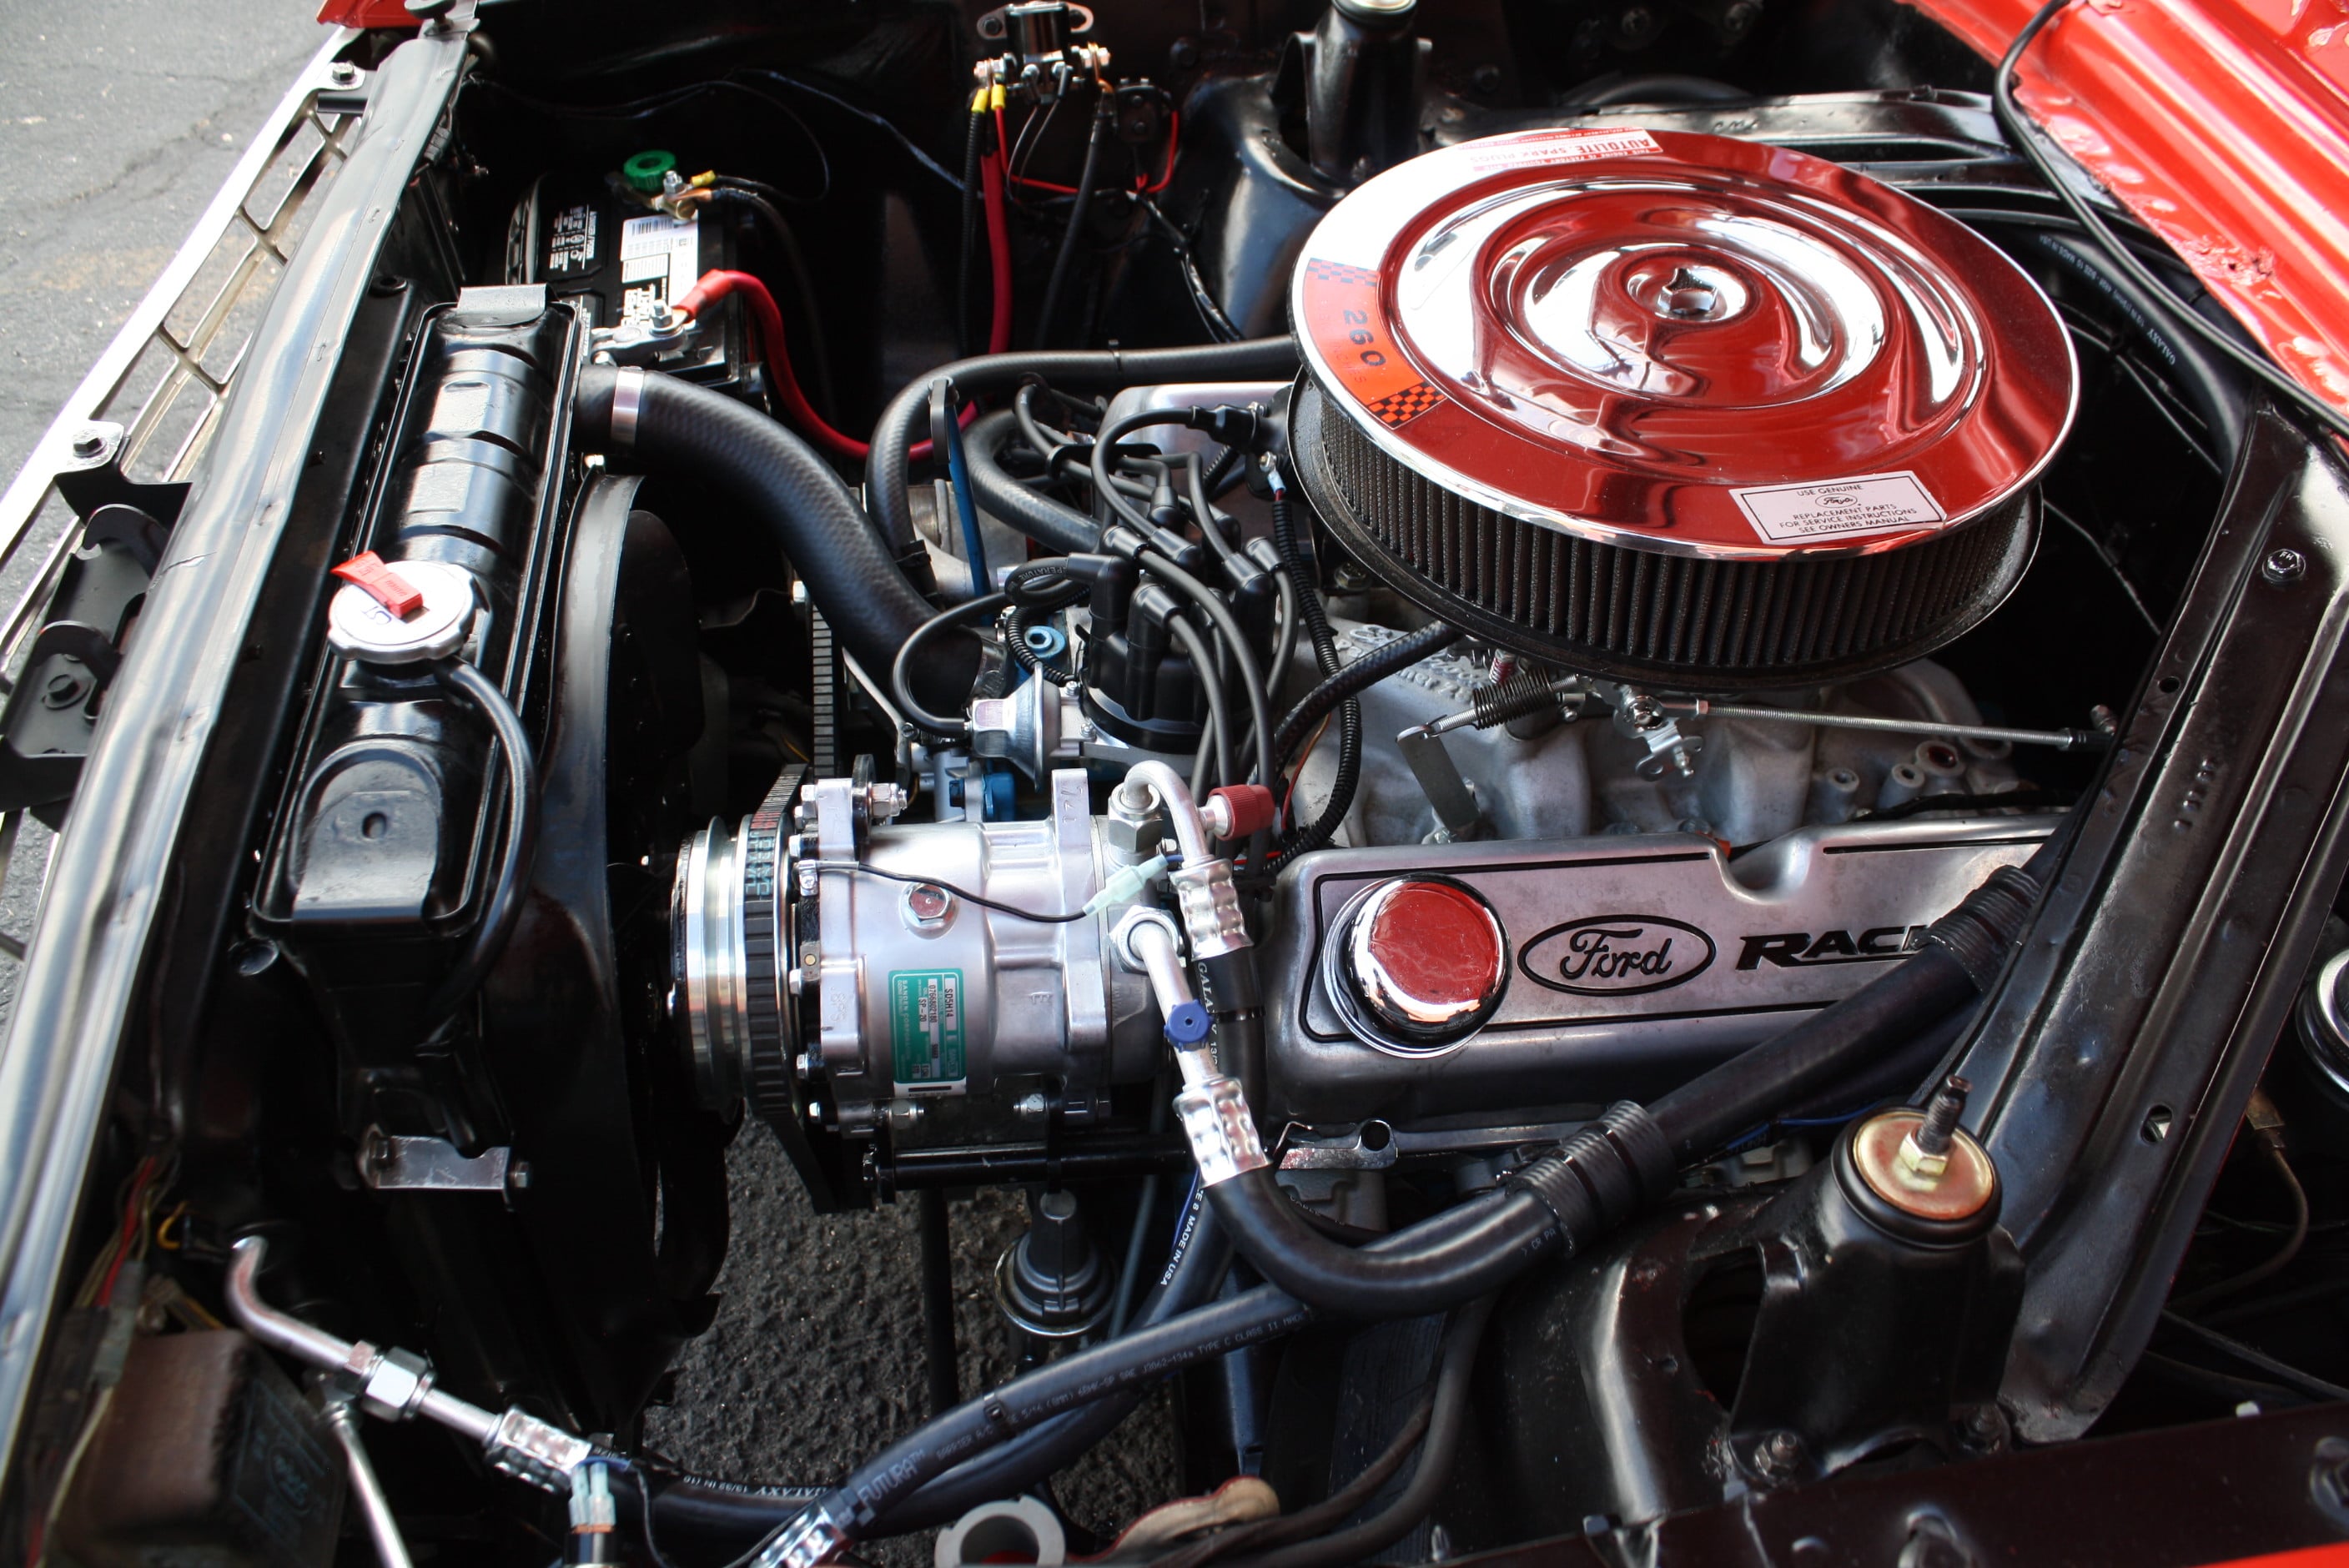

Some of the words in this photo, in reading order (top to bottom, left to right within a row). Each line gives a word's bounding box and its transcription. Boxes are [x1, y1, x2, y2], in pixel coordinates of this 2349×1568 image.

[1575, 138, 1651, 153] AUTOLITE
[1343, 309, 1386, 366] 260
[1820, 485, 1864, 495] GENUINE
[1793, 507, 1864, 520] REPLACEMENT
[1866, 504, 1897, 512] PARTS
[1803, 516, 1843, 526] SERVICE
[1845, 508, 1917, 521] INSTRUCTIONS
[1818, 521, 1863, 531] OWNERS
[1865, 515, 1910, 526] MANUAL
[1558, 928, 1672, 982] Ford
[945, 988, 954, 1017] SD5H14
[1179, 1214, 1195, 1249] MADE
[1173, 1250, 1182, 1263] IN
[1160, 1264, 1176, 1286] USA
[1198, 1340, 1221, 1354] TYPE
[1235, 1327, 1264, 1342] CLASS
